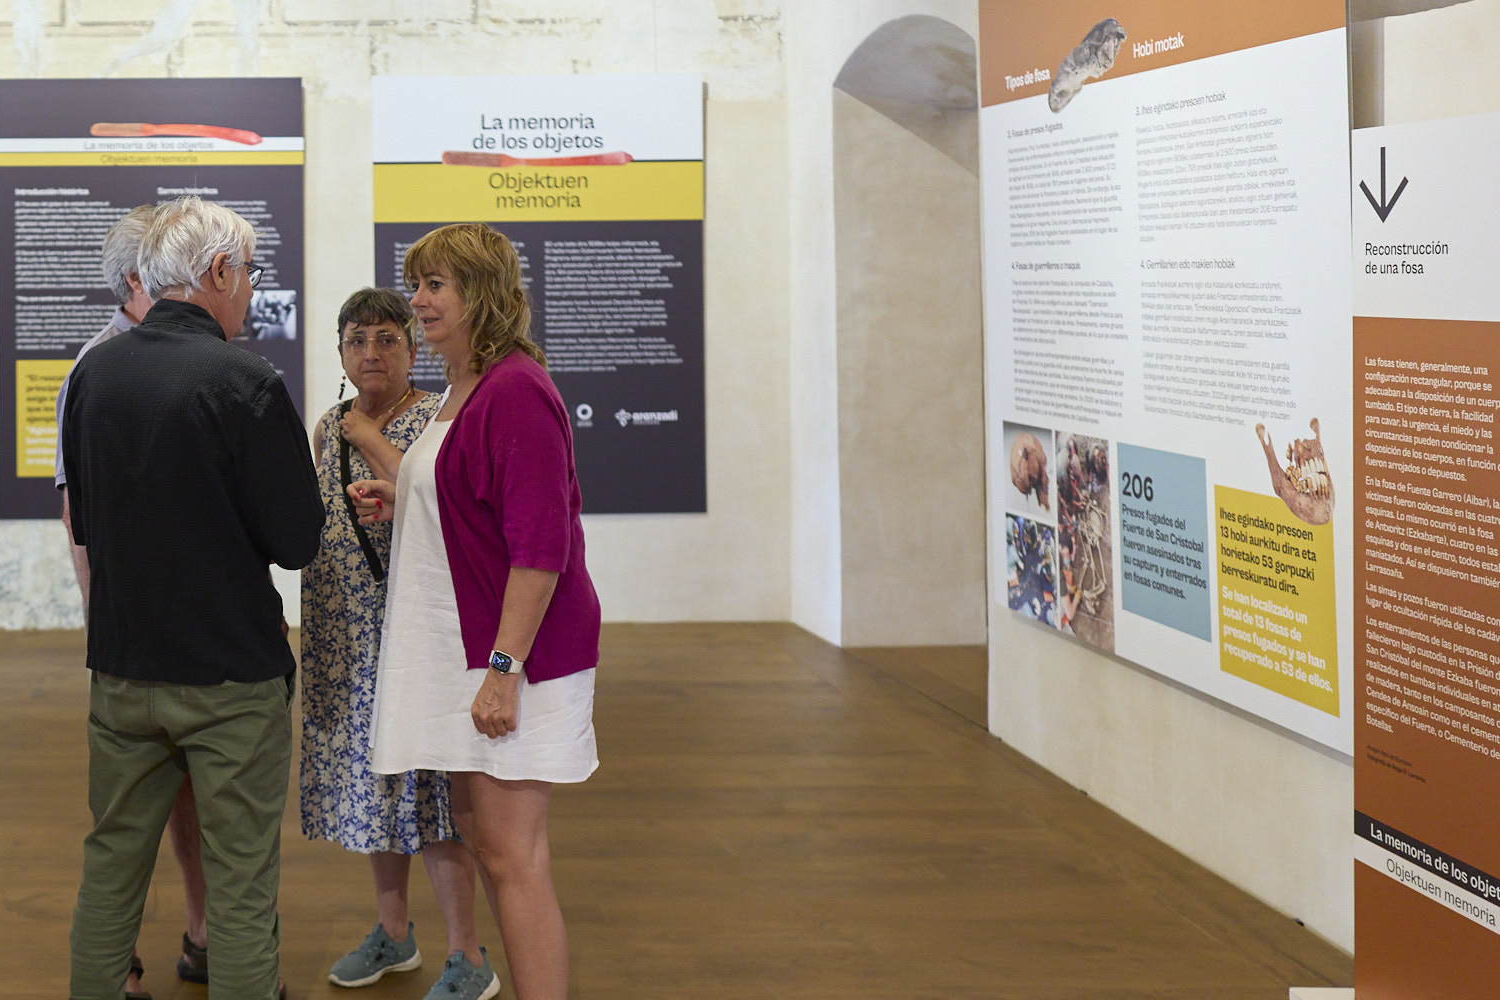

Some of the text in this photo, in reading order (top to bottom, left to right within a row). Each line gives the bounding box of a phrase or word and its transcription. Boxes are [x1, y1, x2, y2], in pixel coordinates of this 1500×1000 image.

[1133, 32, 1184, 58] Hobi motak
[1005, 68, 1050, 92] Tipos de fosa
[481, 113, 595, 130] La memoria
[178, 141, 214, 151] objetos
[473, 133, 604, 152] de los objetos
[101, 154, 152, 166] Objektuen
[489, 172, 588, 193] Objektuen
[497, 192, 581, 208] memoria
[1365, 241, 1448, 255] Reconstrucción
[1365, 261, 1424, 274] de una fosa
[1365, 357, 1488, 375] Las fosas tienen, generalmente, una
[1365, 372, 1492, 391] configuración rectangular, porque se
[1122, 472, 1153, 501] 206
[1122, 504, 1185, 530] Presos fugados del
[1220, 507, 1313, 541] Ihes egindako presoen
[1123, 520, 1203, 553] Fuerte de San Cristobal
[1221, 526, 1316, 561] 13 hobi aurkitu dira eta
[1124, 536, 1201, 570] fueron asesinados tras
[1221, 544, 1314, 580] horietako 53 gorpuzki
[1124, 555, 1206, 589] su captura y enterrados
[1222, 562, 1299, 595] berreskuratu dira.
[1366, 561, 1404, 579] Larrasoaña.
[1124, 570, 1186, 599] en fosas comunes.
[1222, 586, 1307, 624] Se han localizado un
[1223, 605, 1301, 642] total de 13 fosas de
[1224, 624, 1326, 670] presos fugados y se han
[1224, 643, 1333, 692] recuperado a 53 de ellos.
[1366, 714, 1394, 733] Botellas.
[1371, 823, 1383, 841] La
[1385, 833, 1432, 866] memoria
[1435, 856, 1448, 874] de
[1452, 863, 1468, 883] los
[1387, 858, 1496, 926] Objektuen memoria
